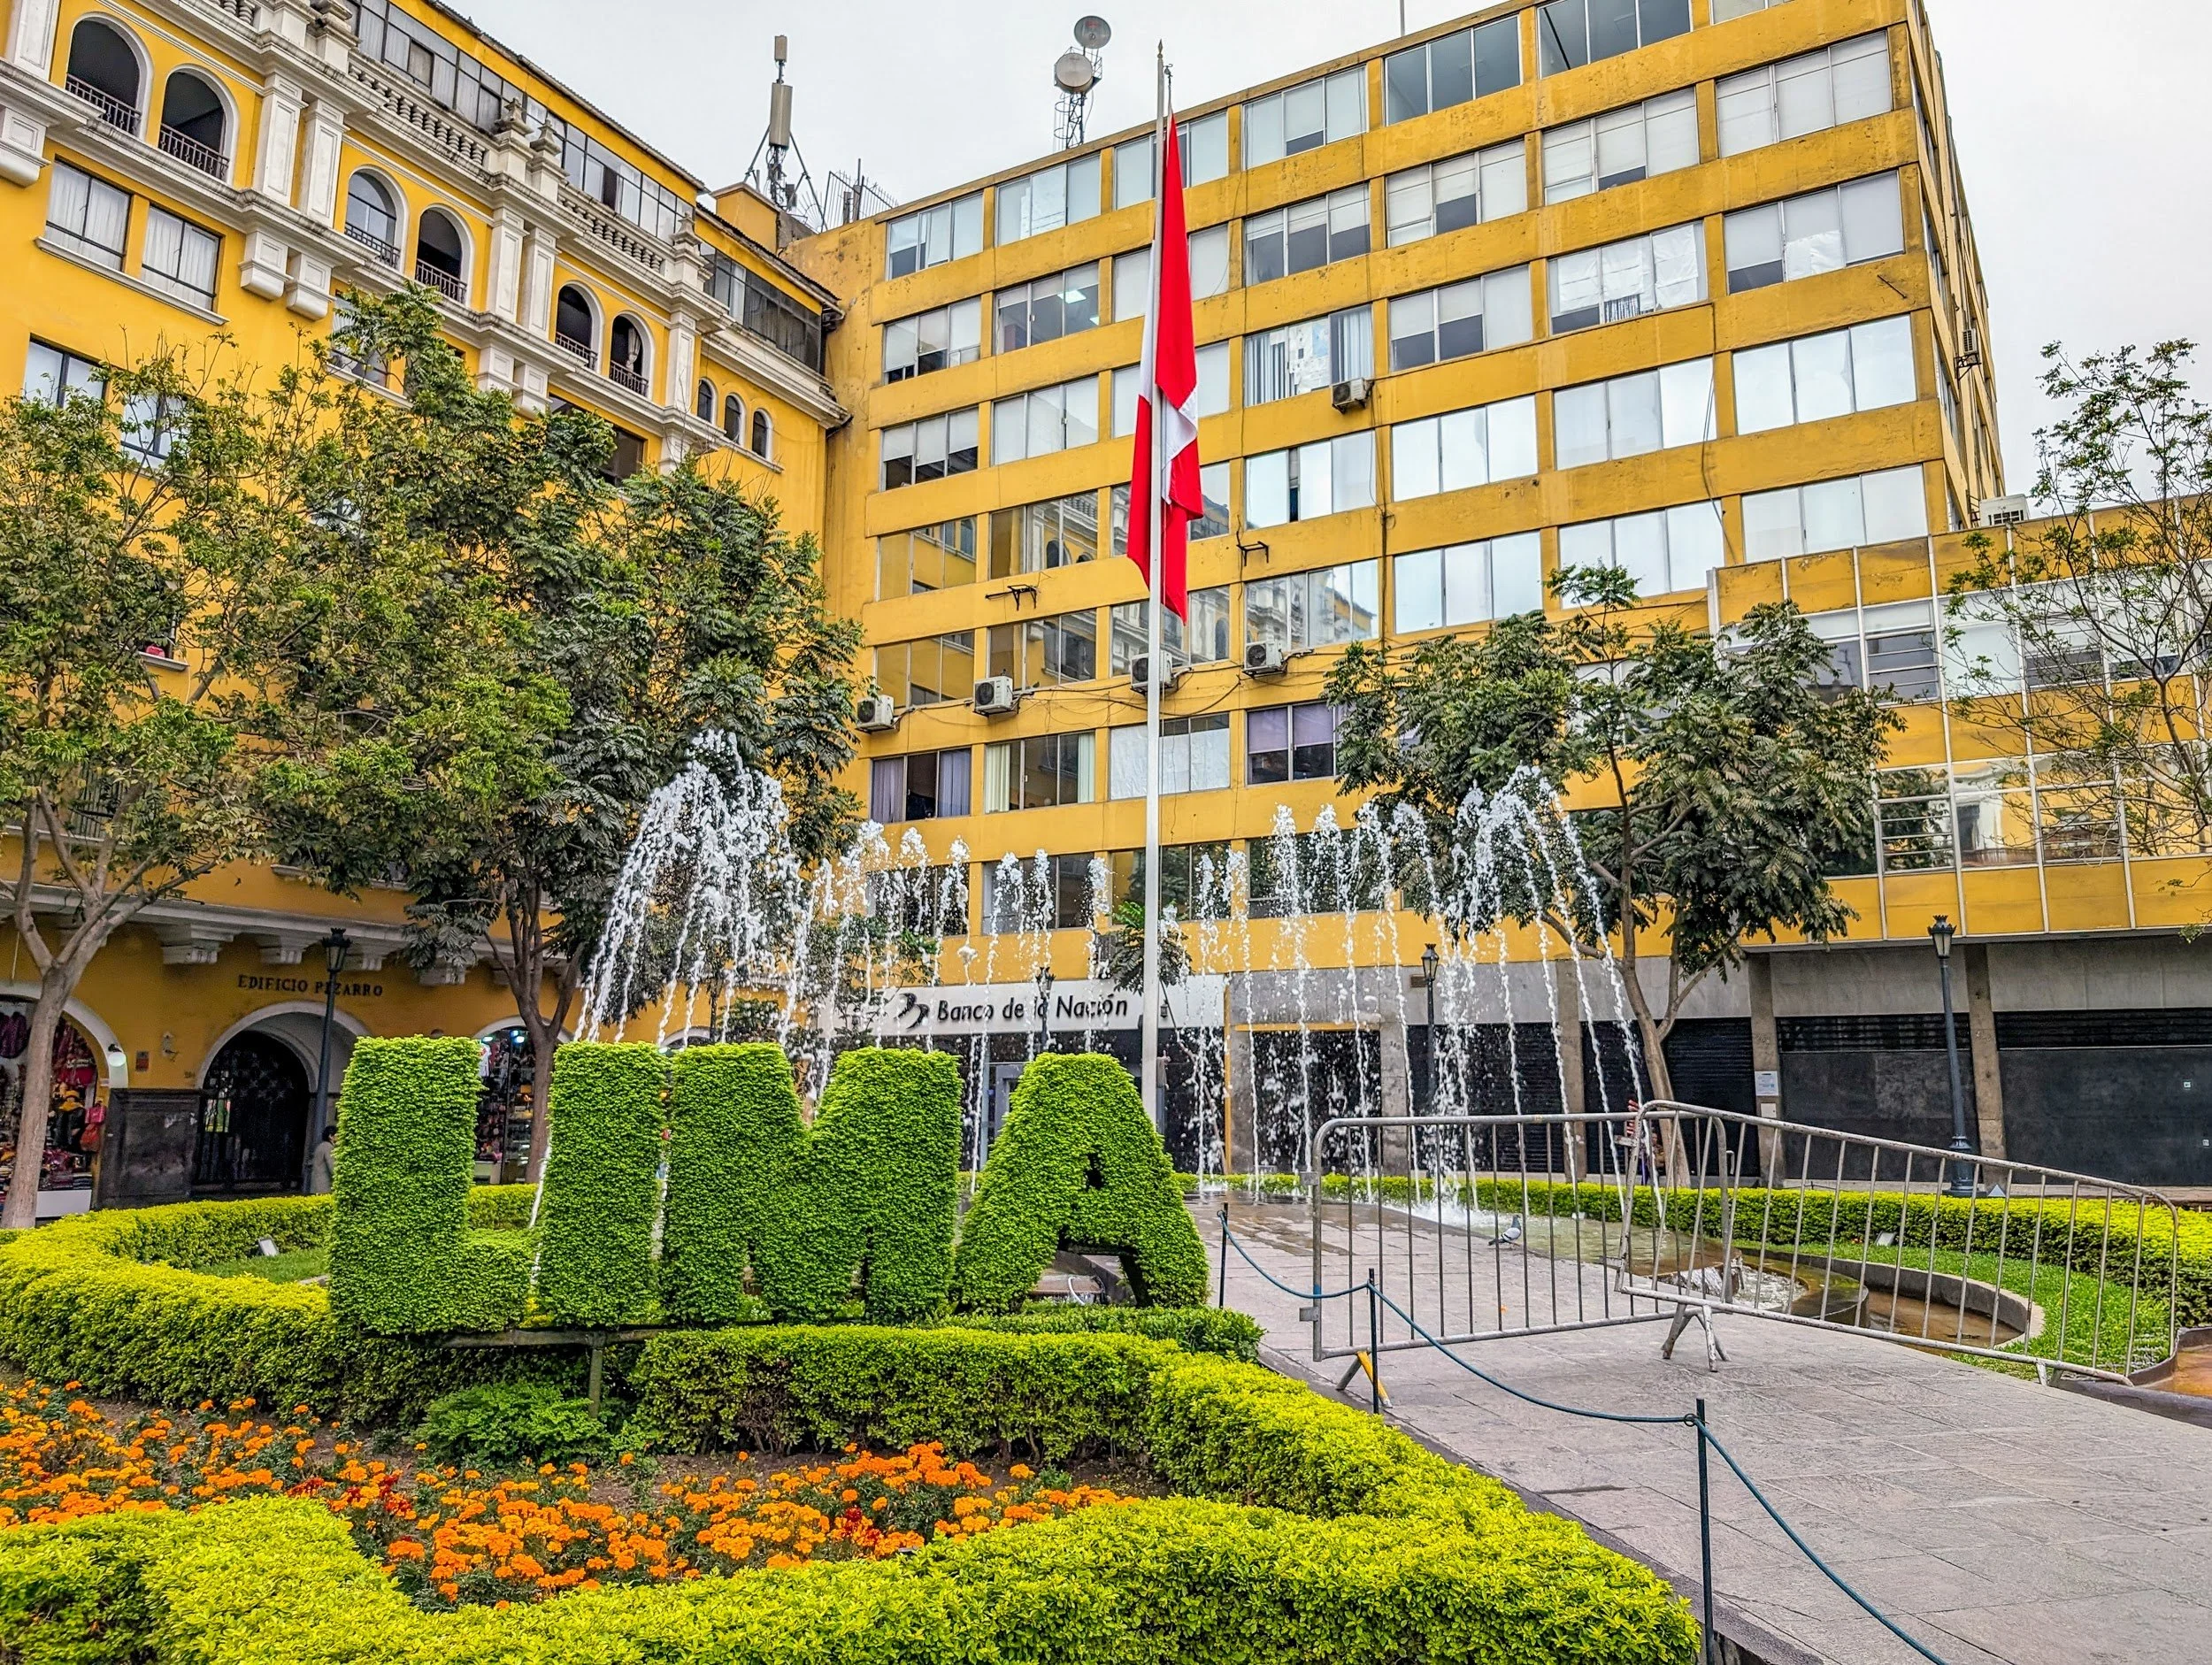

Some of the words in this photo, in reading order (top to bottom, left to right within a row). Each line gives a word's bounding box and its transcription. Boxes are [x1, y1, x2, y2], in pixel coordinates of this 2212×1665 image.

[237, 974, 309, 993] EDIFICIO
[937, 1000, 995, 1021] Banco
[1002, 997, 1025, 1019] de
[1056, 993, 1128, 1018] Nación
[327, 1034, 1210, 1337] LIMA
